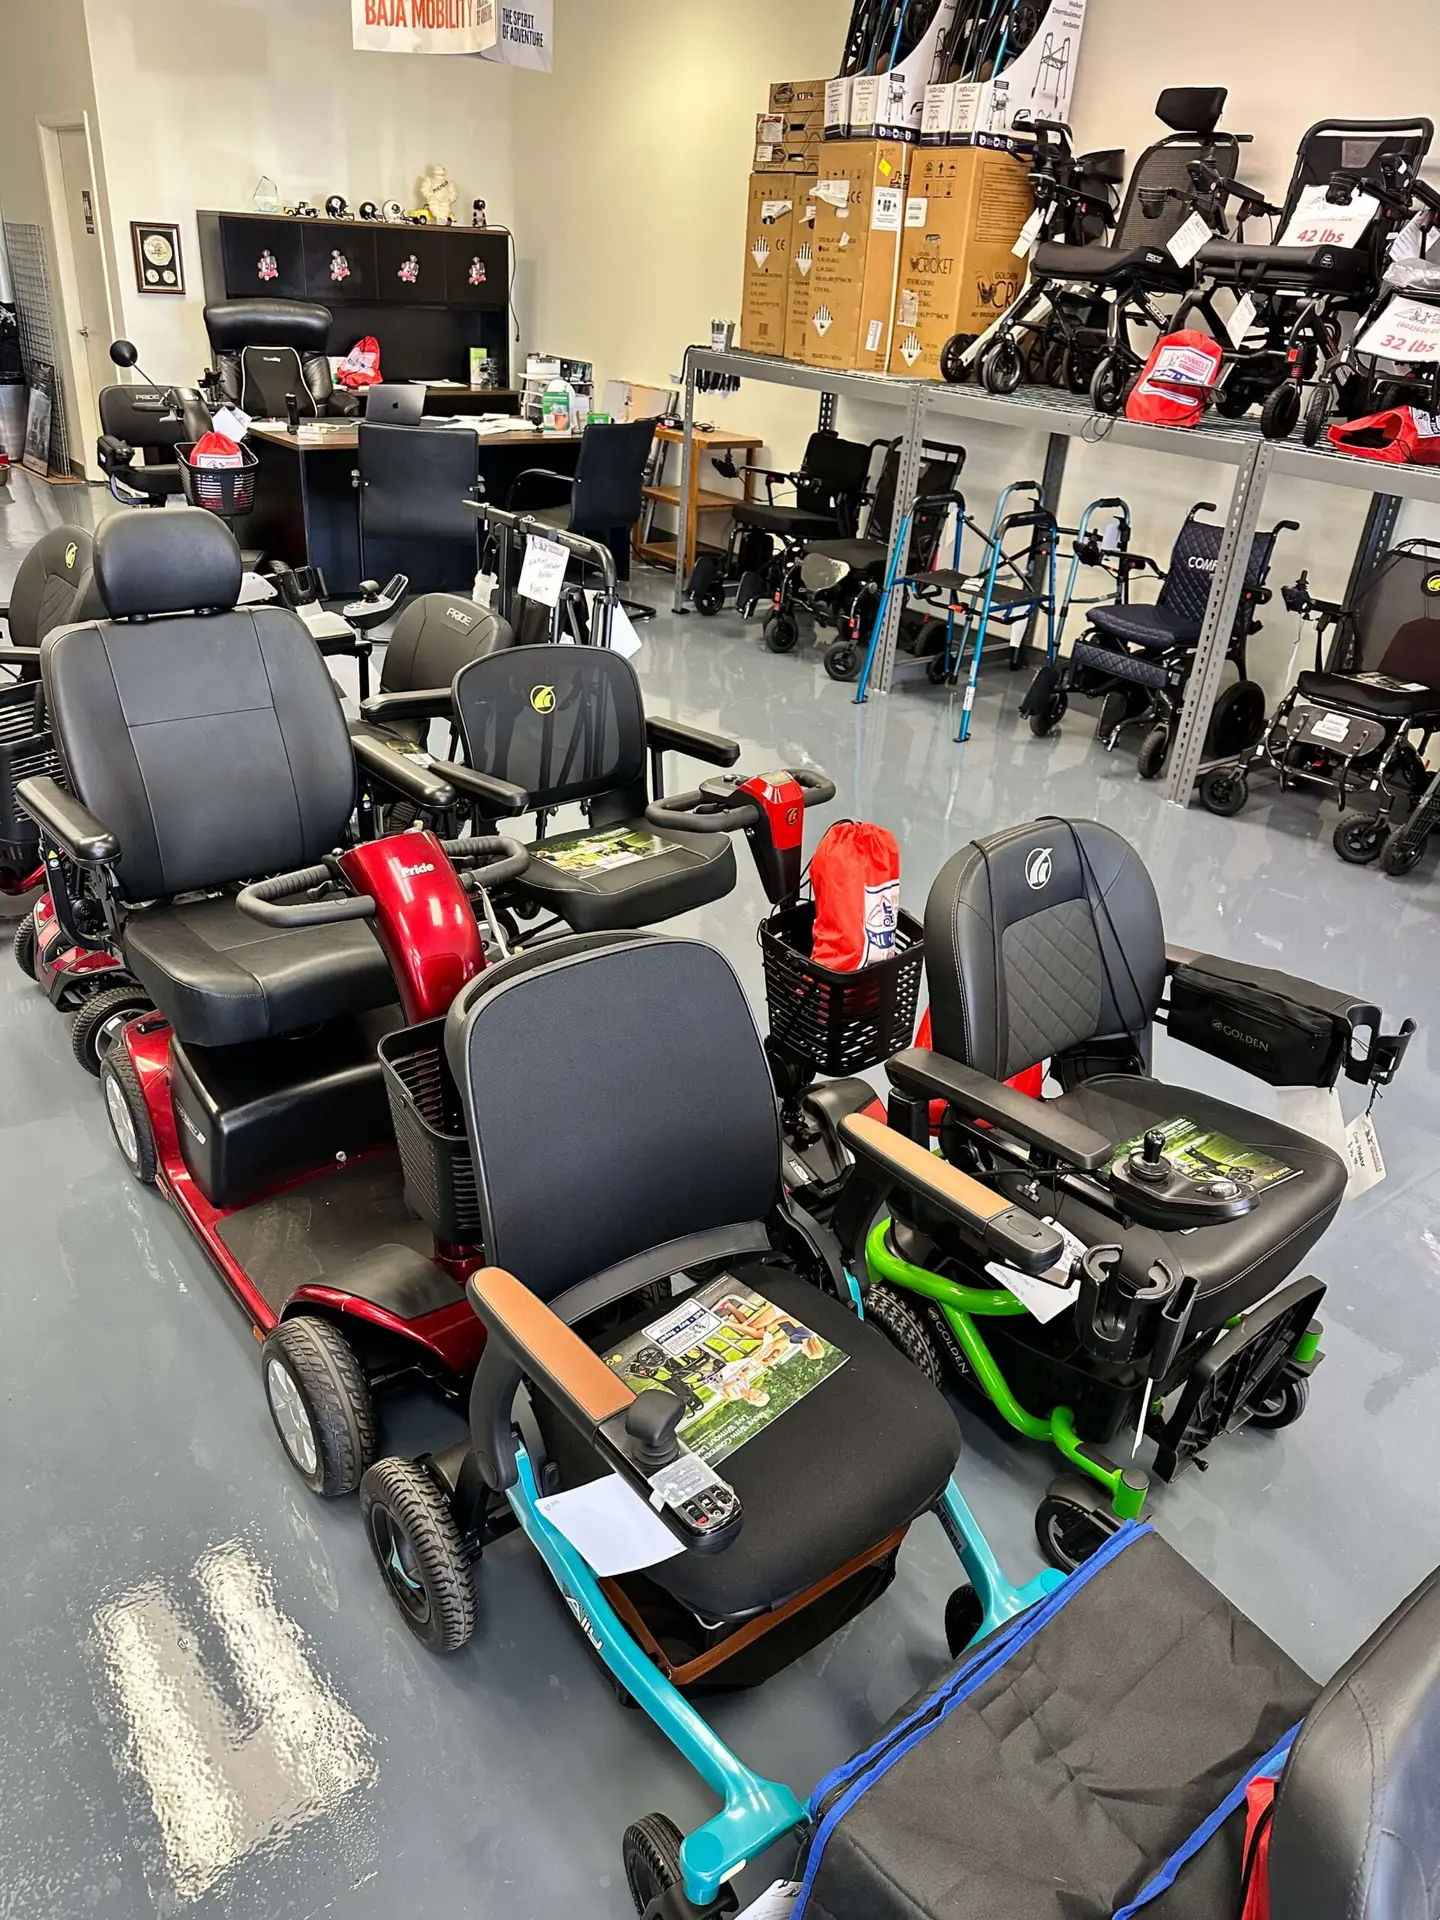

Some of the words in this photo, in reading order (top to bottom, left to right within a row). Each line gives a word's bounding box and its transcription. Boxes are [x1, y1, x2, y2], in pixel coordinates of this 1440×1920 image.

[365, 0, 407, 28] BAJA
[411, 0, 473, 29] MOBILITY
[502, 7, 513, 25] THE
[513, 11, 535, 30] SPIRIT
[502, 24, 510, 40] OF
[510, 26, 544, 48] ADVENTURE
[1297, 229, 1317, 243] 42
[1319, 229, 1345, 243] lbs
[917, 257, 954, 275] CRICKET
[994, 271, 1019, 280] GOLDEN
[1380, 334, 1407, 350] 32
[1408, 340, 1438, 352] lbs
[1188, 556, 1219, 571] COMF
[446, 607, 472, 626] PRIDE
[400, 863, 434, 878] Pride
[1223, 1025, 1269, 1052] GOLDEN
[694, 1309, 705, 1320] Sell
[658, 1329, 676, 1344] Repair
[936, 1321, 970, 1373] GOLDEN
[708, 1425, 737, 1447] WITHOUT
[731, 1425, 749, 1438] WITH
[701, 1438, 732, 1461] CONFIDEN
[564, 1595, 603, 1650] Ally
